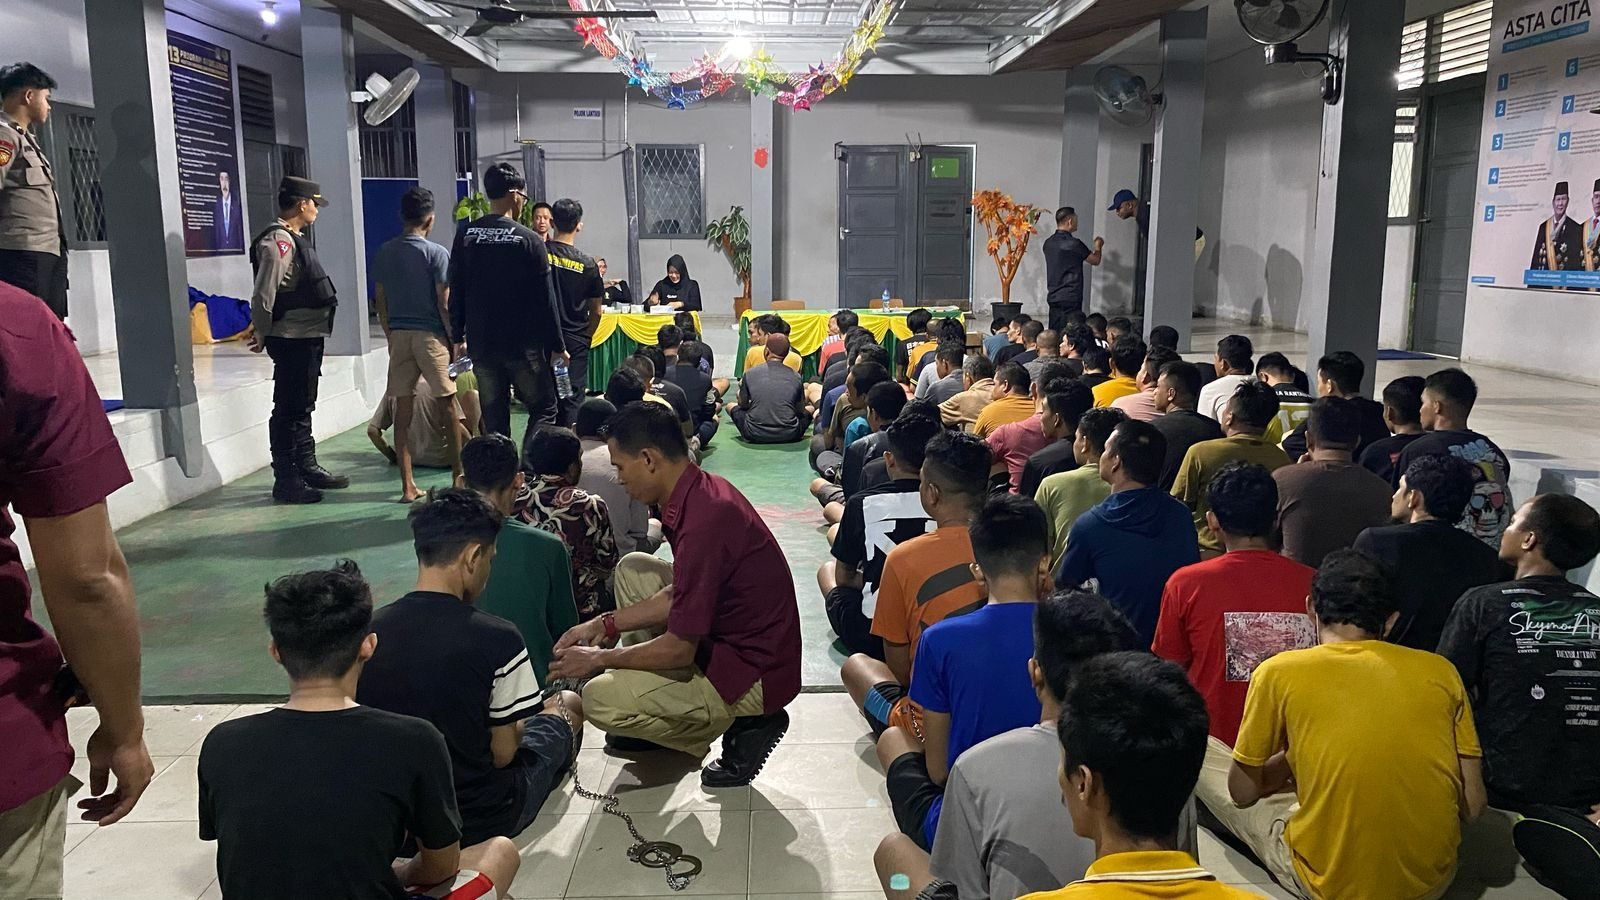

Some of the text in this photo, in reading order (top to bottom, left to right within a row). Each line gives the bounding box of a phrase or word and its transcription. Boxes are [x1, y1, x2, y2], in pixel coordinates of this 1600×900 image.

[1503, 11, 1545, 40] ASTA
[1551, 0, 1591, 26] CITA
[168, 44, 180, 63] 13
[1569, 62, 1575, 74] 6
[1498, 104, 1504, 114] 2
[1565, 99, 1572, 111] 7
[1494, 137, 1501, 148] 3
[1560, 136, 1567, 147] 8
[1490, 171, 1497, 181] 4
[1486, 208, 1492, 218] 5
[466, 227, 516, 235] PRISON
[476, 234, 523, 243] POLICE
